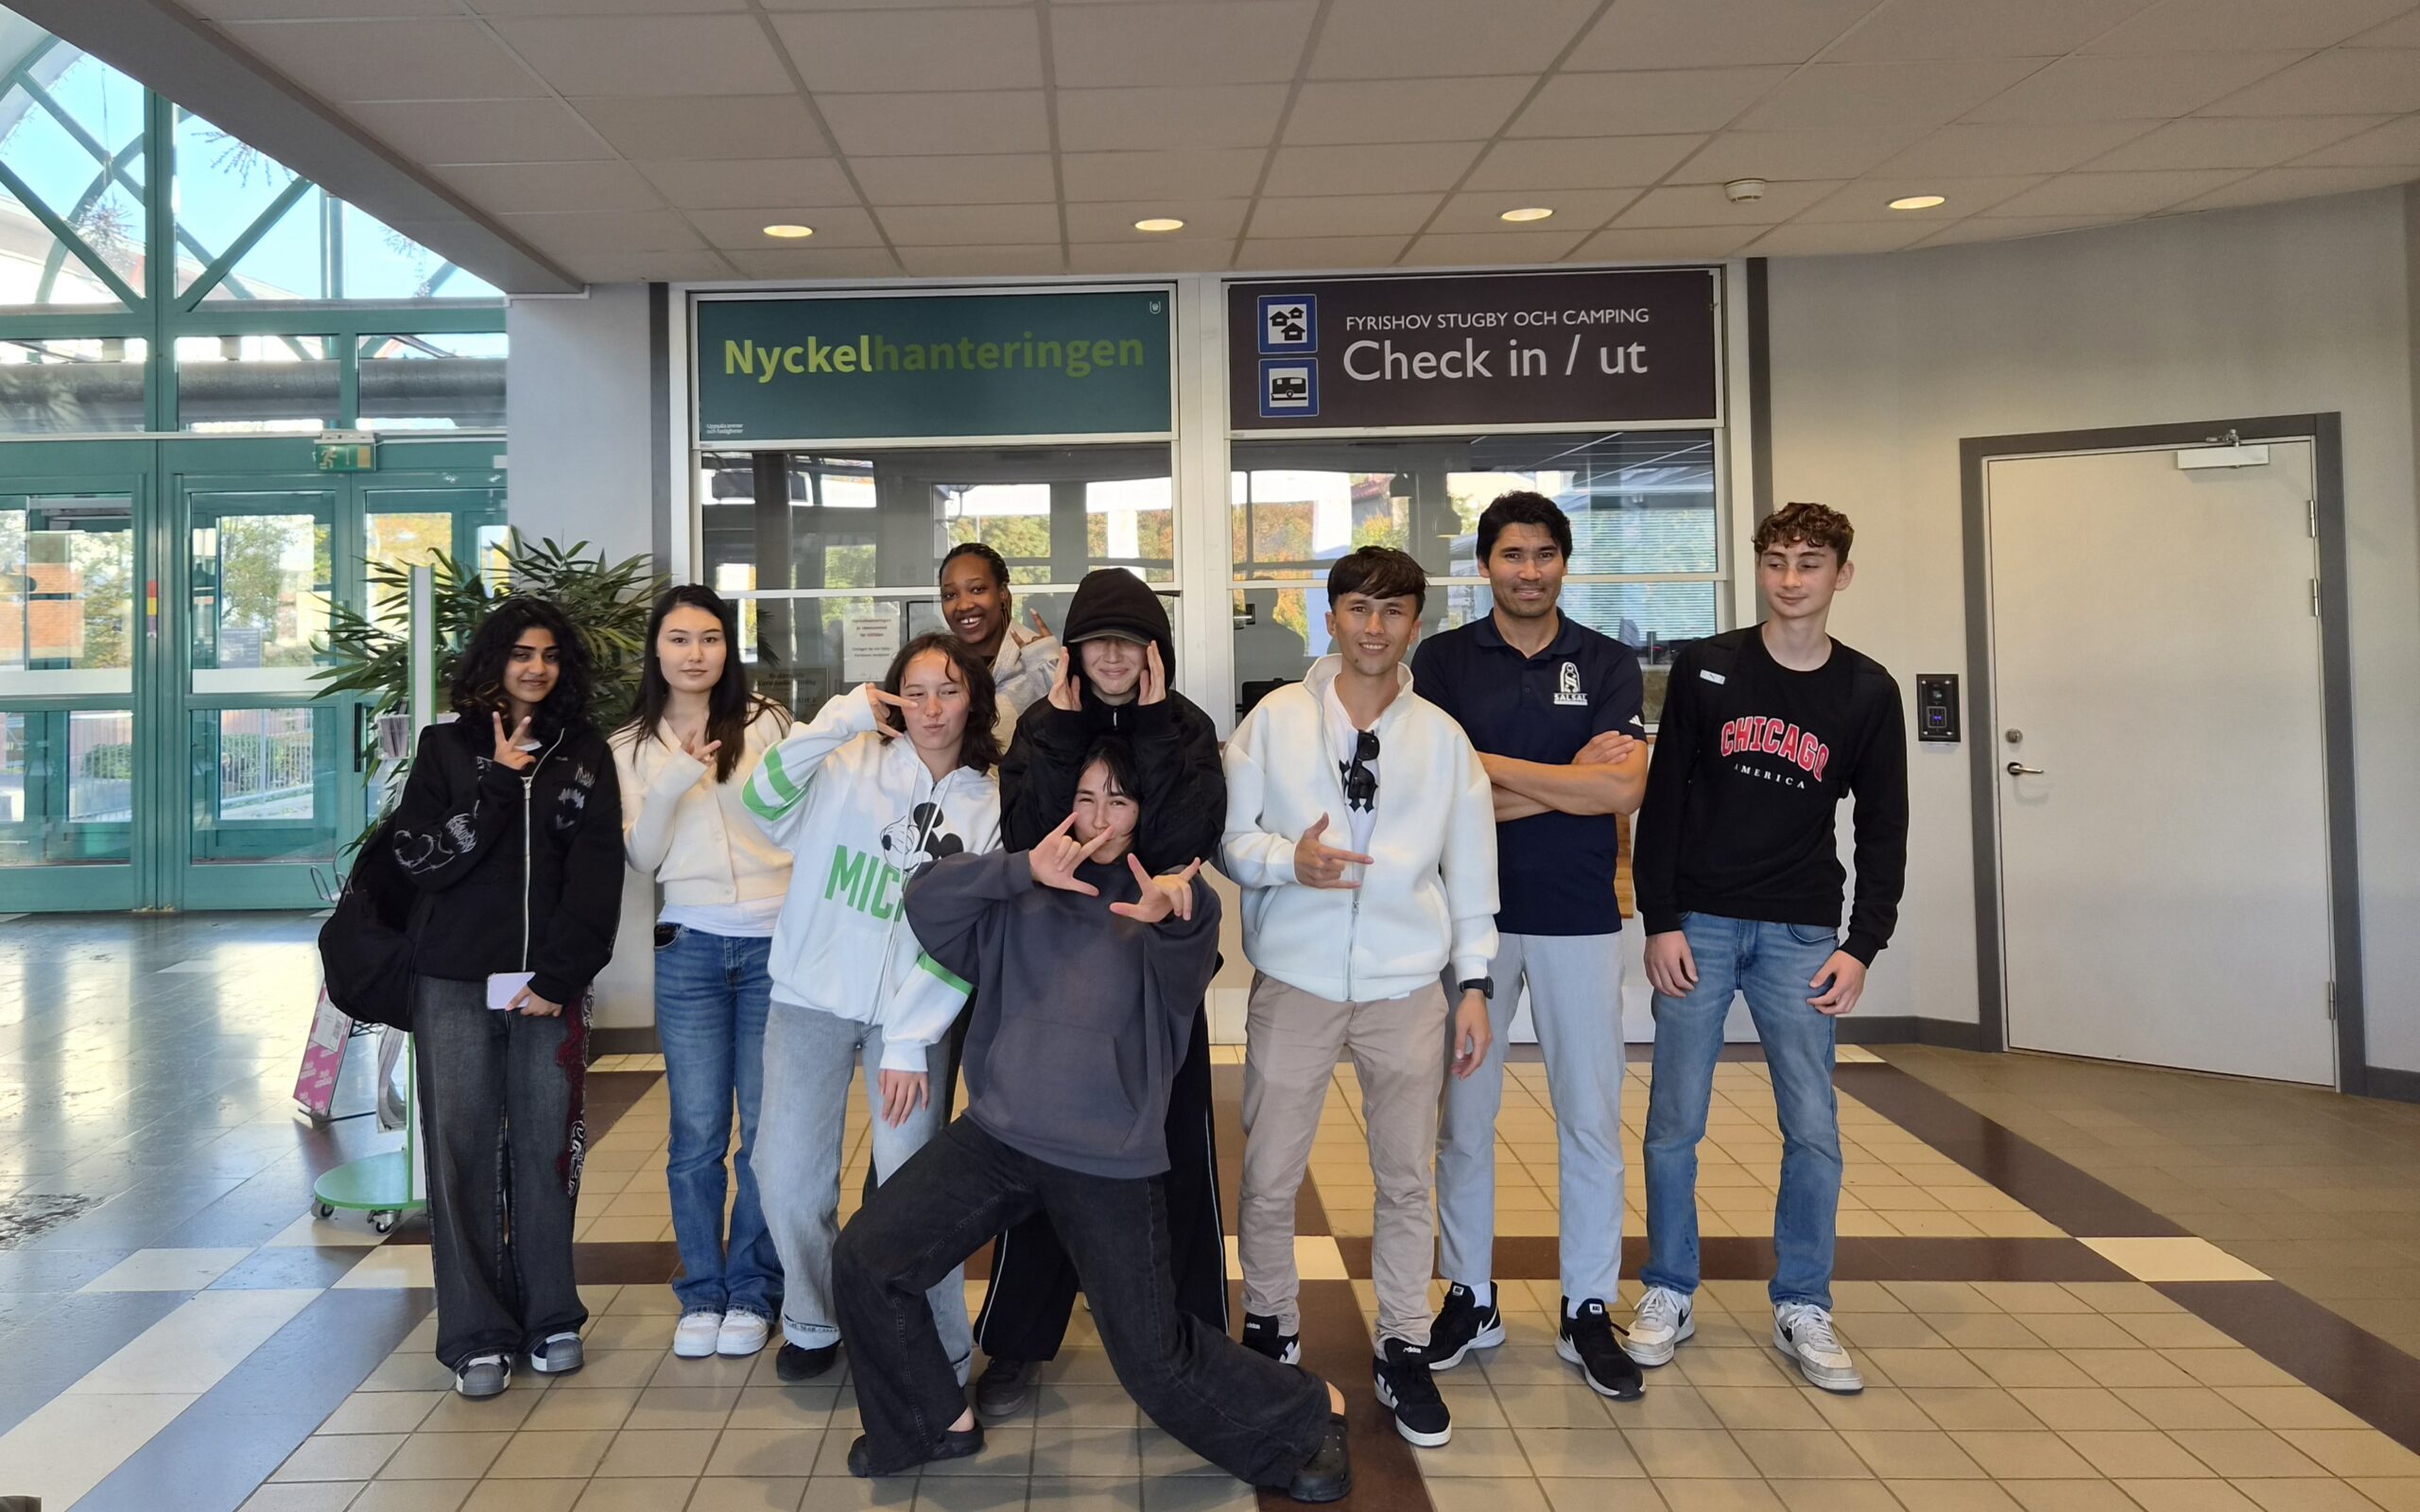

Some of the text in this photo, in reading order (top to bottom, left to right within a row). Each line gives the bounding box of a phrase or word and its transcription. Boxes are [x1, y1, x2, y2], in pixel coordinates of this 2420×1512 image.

[1345, 307, 1651, 332] FYRISHOV STUGBY OCH CAMPING
[724, 331, 1145, 384] Nyckelhanteringen
[1342, 334, 1649, 382] Check in / ut
[1553, 693, 1588, 701] SALSAL
[1720, 715, 1830, 782] CHICAGO
[824, 844, 908, 923] MIC
